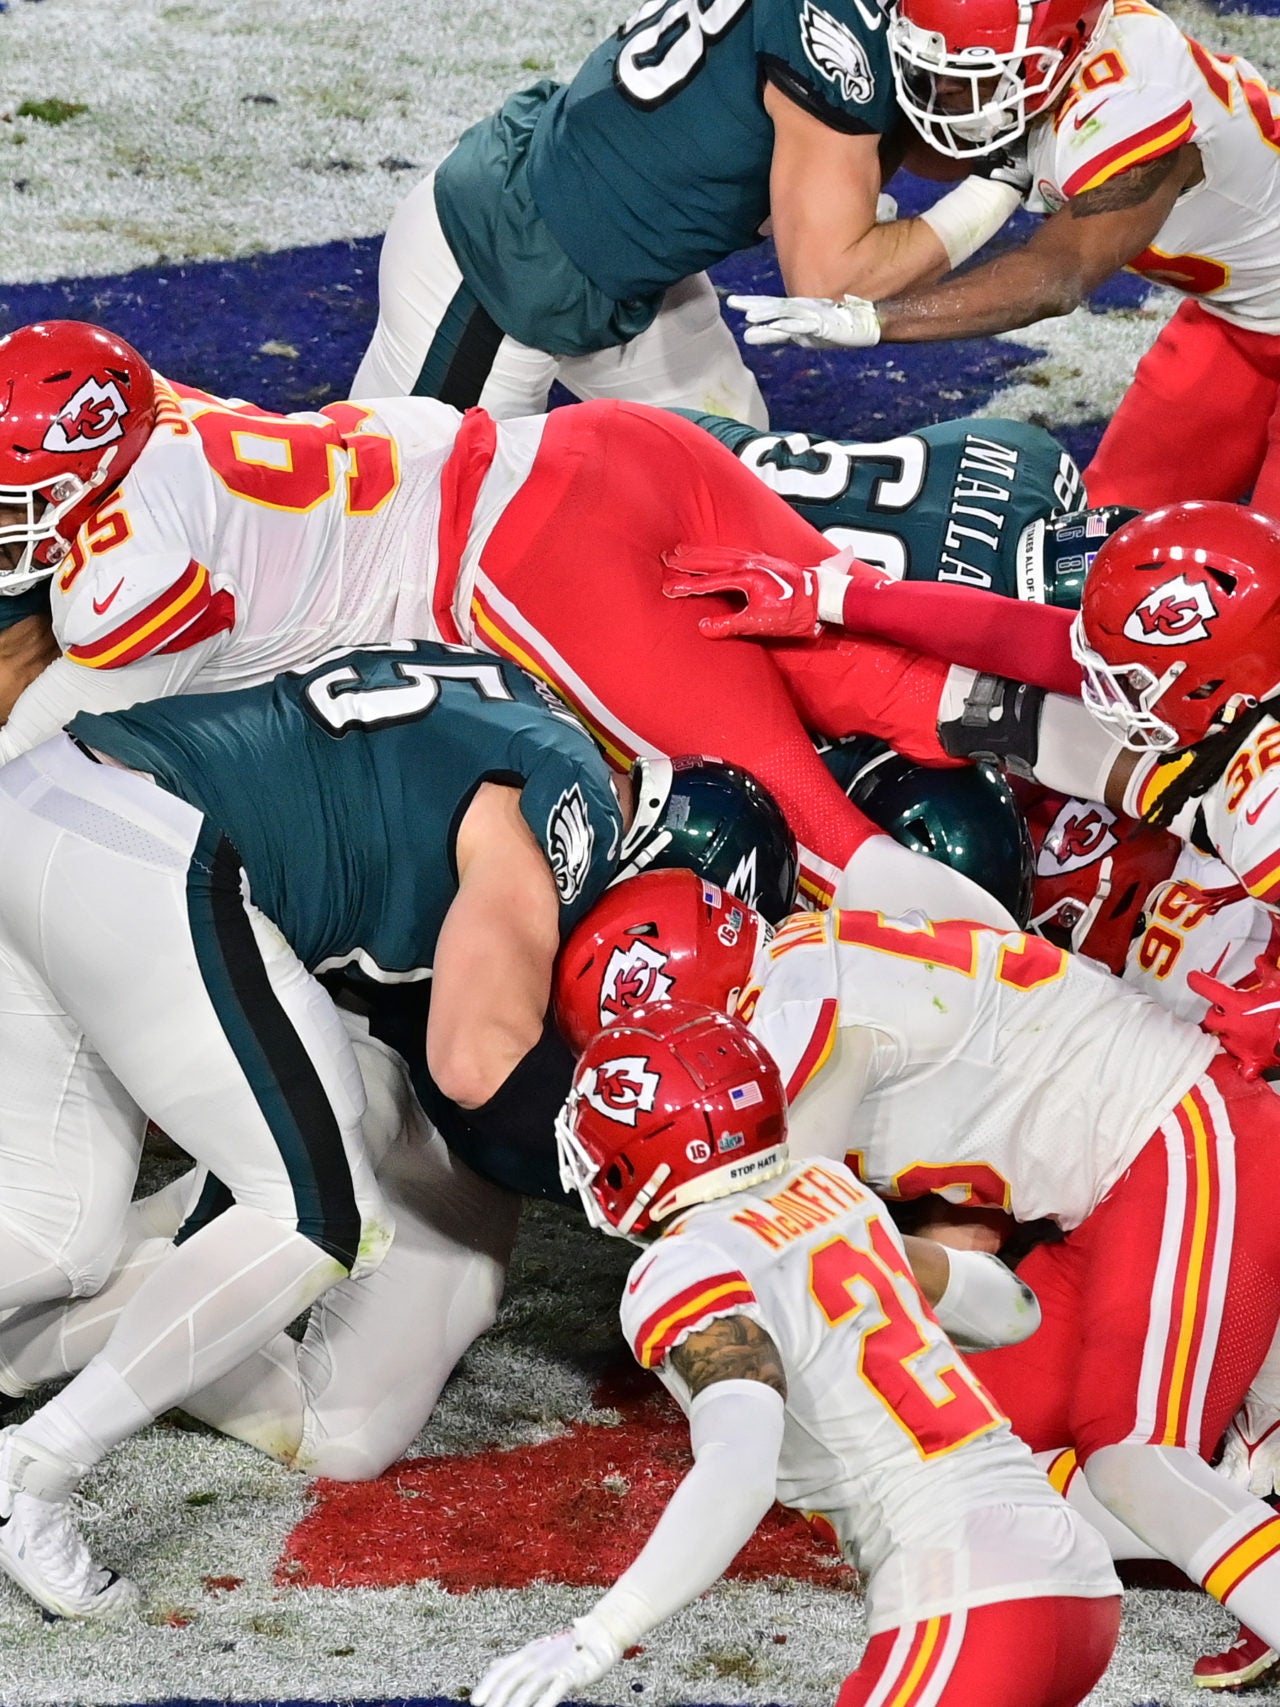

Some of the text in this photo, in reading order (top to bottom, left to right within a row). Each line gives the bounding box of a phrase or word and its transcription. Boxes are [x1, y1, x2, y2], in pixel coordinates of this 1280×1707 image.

[1025, 556, 1034, 575] ALL
[1026, 578, 1035, 592] OF
[689, 1143, 707, 1161] 16
[730, 1153, 778, 1179] STOP HATE
